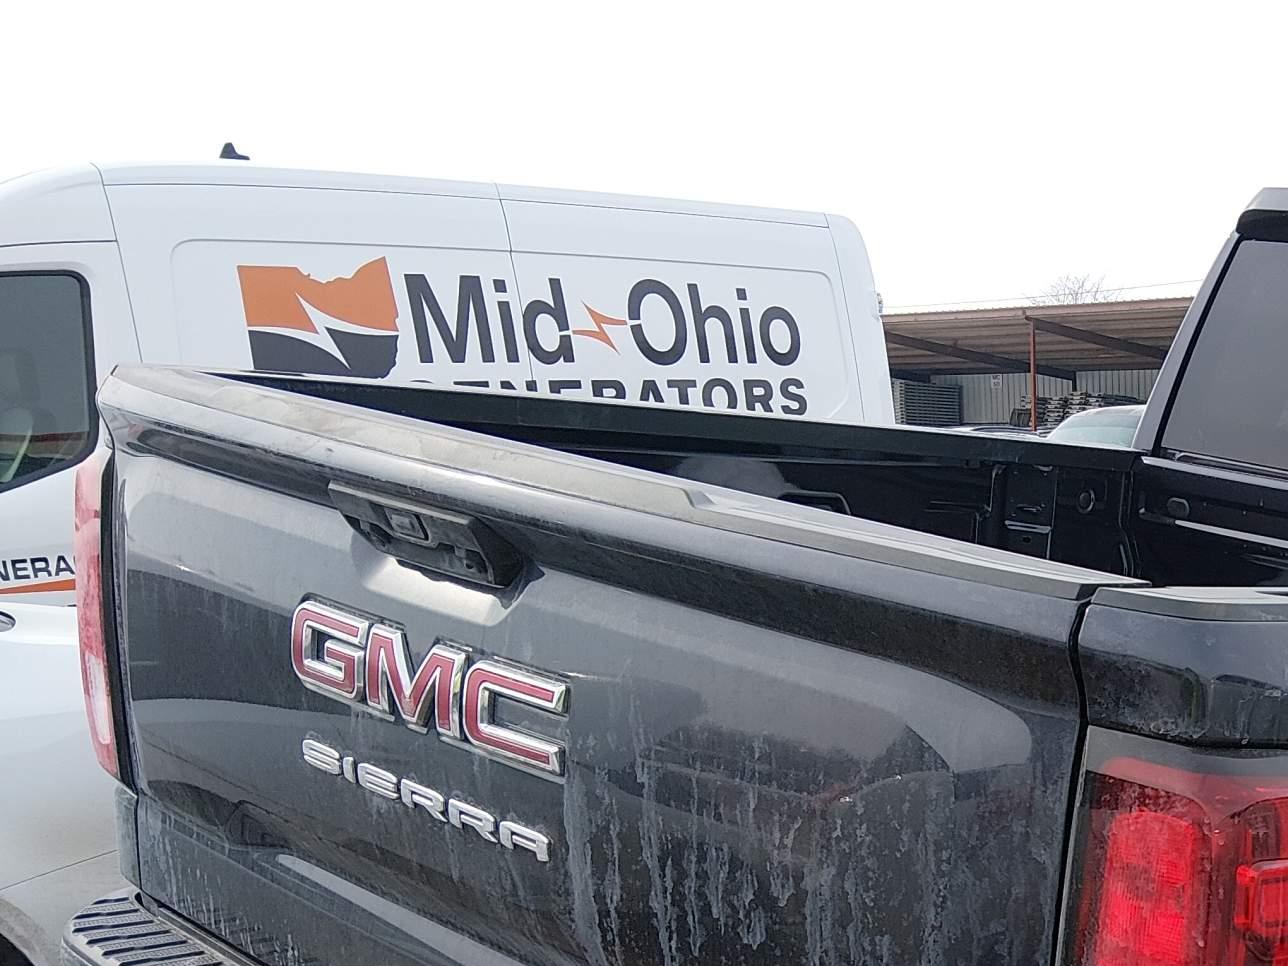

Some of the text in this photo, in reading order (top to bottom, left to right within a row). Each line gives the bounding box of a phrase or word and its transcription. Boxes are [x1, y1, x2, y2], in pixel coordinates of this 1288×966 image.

[403, 273, 801, 367] Mid Ohio
[0, 554, 77, 581] NERA
[291, 600, 569, 779] GMC
[301, 738, 553, 863] SIERRA
